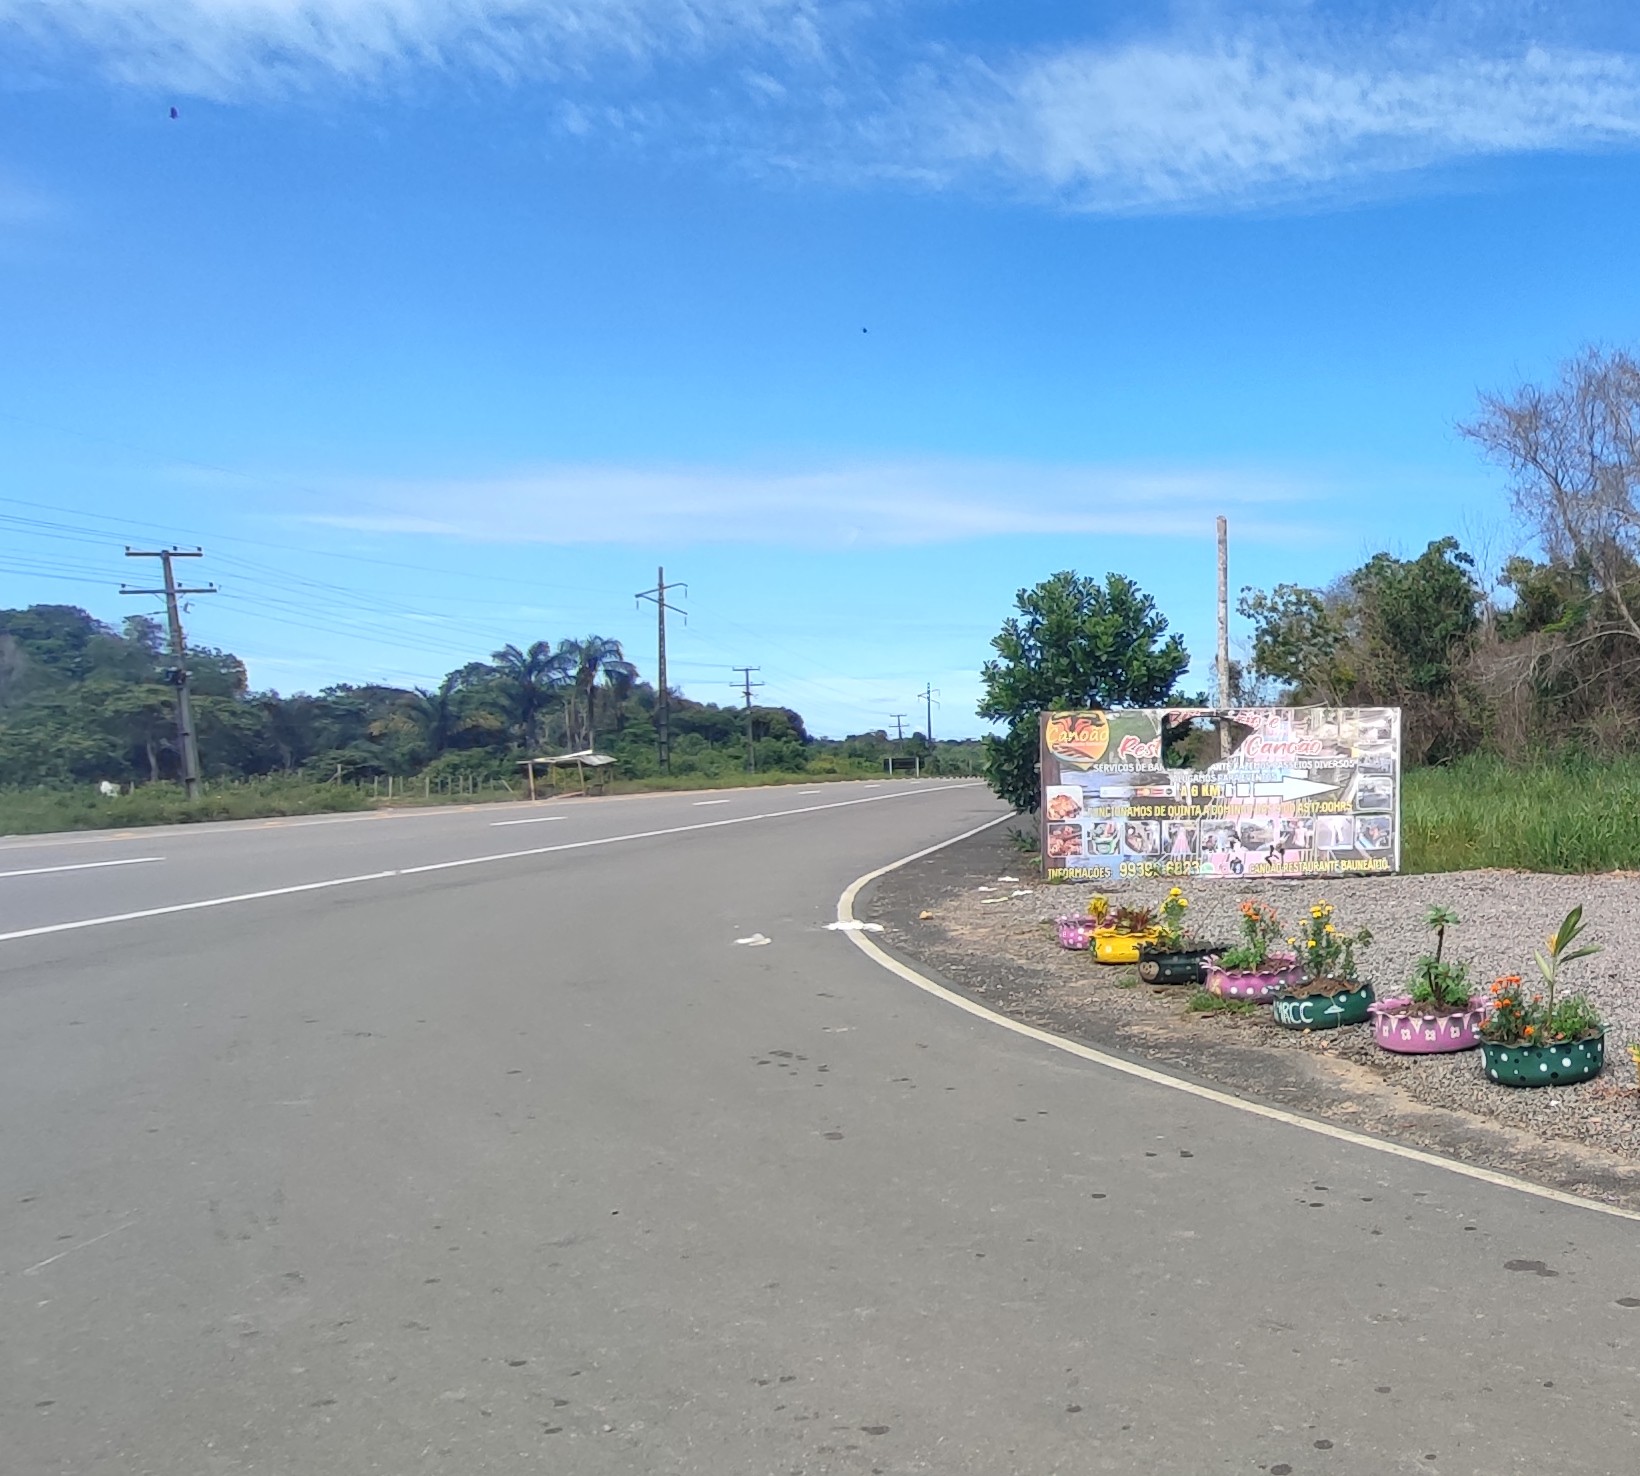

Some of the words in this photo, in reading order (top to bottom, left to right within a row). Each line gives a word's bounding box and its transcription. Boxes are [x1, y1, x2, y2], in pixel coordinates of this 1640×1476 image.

[1246, 735, 1323, 757] Canoão
[1093, 763, 1134, 773] SERVIÇOS
[1136, 763, 1147, 772] DE
[1315, 759, 1354, 769] DIVERSOS
[1202, 785, 1220, 797] KM
[1154, 805, 1166, 816] DE
[1168, 804, 1202, 816] QUINTA
